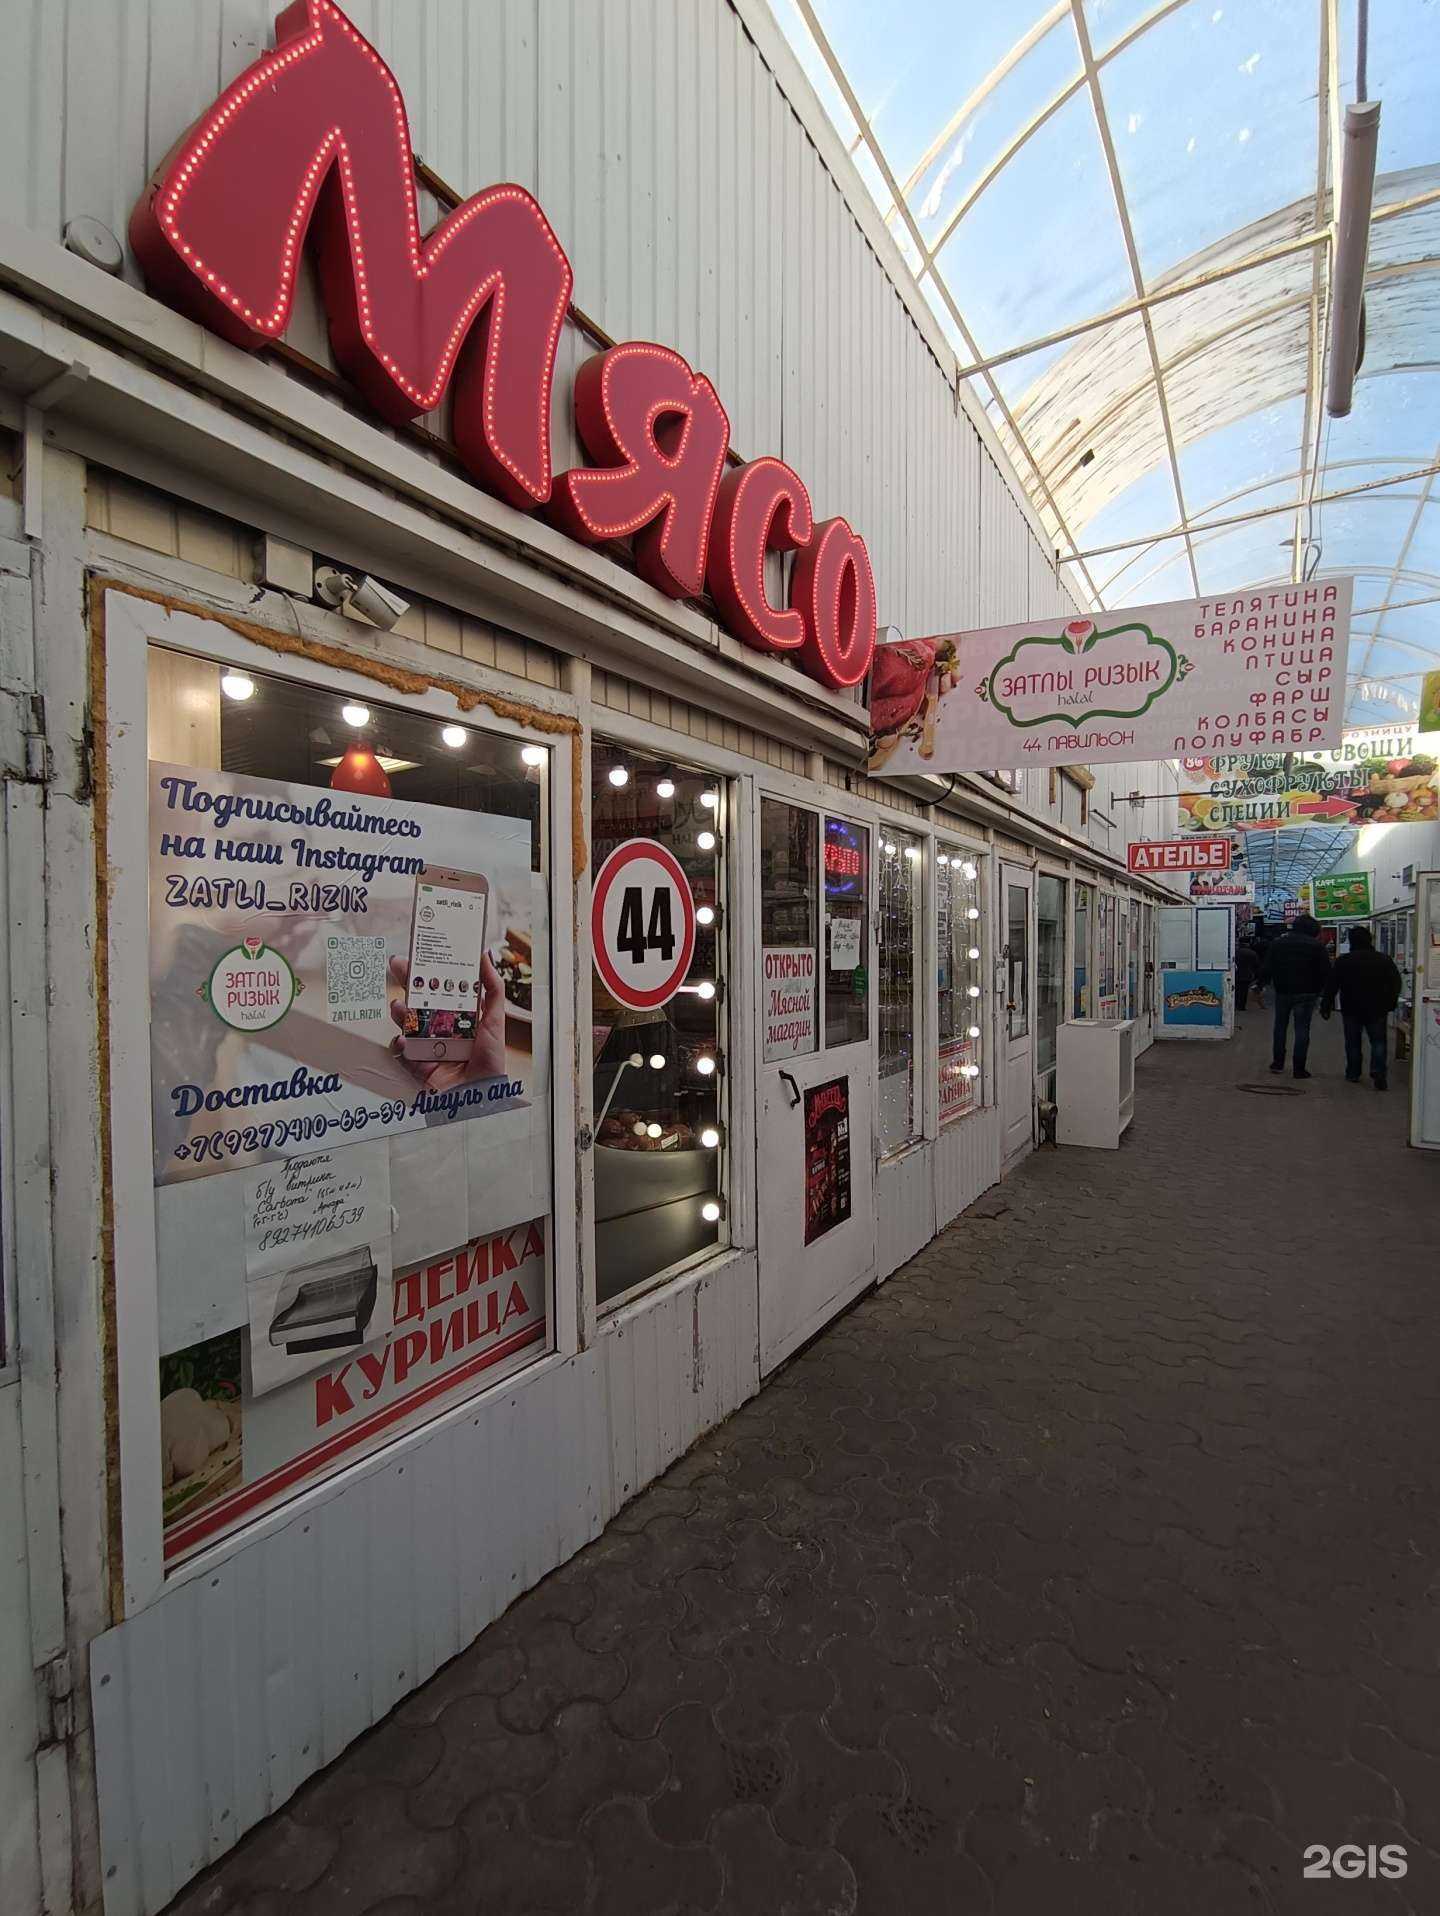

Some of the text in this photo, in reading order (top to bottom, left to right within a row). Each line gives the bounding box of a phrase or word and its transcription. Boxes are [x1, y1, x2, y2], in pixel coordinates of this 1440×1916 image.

[1200, 586, 1338, 619] ТЕЛЯТИНА
[1194, 605, 1337, 638] БАРАНИНА
[1224, 626, 1336, 654] КОНИНА
[1245, 647, 1334, 671] ПТИЦА
[1002, 659, 1161, 697] ЗАТЛЫ РИЗЫК
[1276, 667, 1332, 686] СЫР
[1057, 690, 1095, 706] halal
[1250, 686, 1331, 707] ФАРШ
[1198, 707, 1329, 731] КОЛБАСЫ
[1023, 730, 1135, 753] 44 ПАВИЛЬОН
[1174, 727, 1326, 751] ПОЛУФАБР.
[1209, 768, 1369, 799] СУХОФРУКТЫ
[160, 777, 422, 838] Подписывайтесь
[1209, 801, 1291, 823] СПЕЦИИ
[160, 832, 428, 883] на наш Instagram
[1134, 844, 1225, 868] АТЕЛЬЕ
[165, 873, 369, 914] ZATLI_RIZIK
[617, 887, 676, 964] 44
[225, 970, 280, 989] ЗАТЛЫ
[765, 953, 813, 979] ОТКРЫТО
[227, 989, 280, 1009] РИЗЫК
[768, 990, 811, 1018] Мясной
[766, 1023, 812, 1050] магазин
[171, 1066, 342, 1118] Доставка
[174, 1078, 524, 1163] +7(927)410-65-39 Айгуль апа
[258, 1206, 365, 1251] 89274106539
[392, 1222, 545, 1325] ДЕЙКА
[314, 1280, 530, 1428] КУРИЦА
